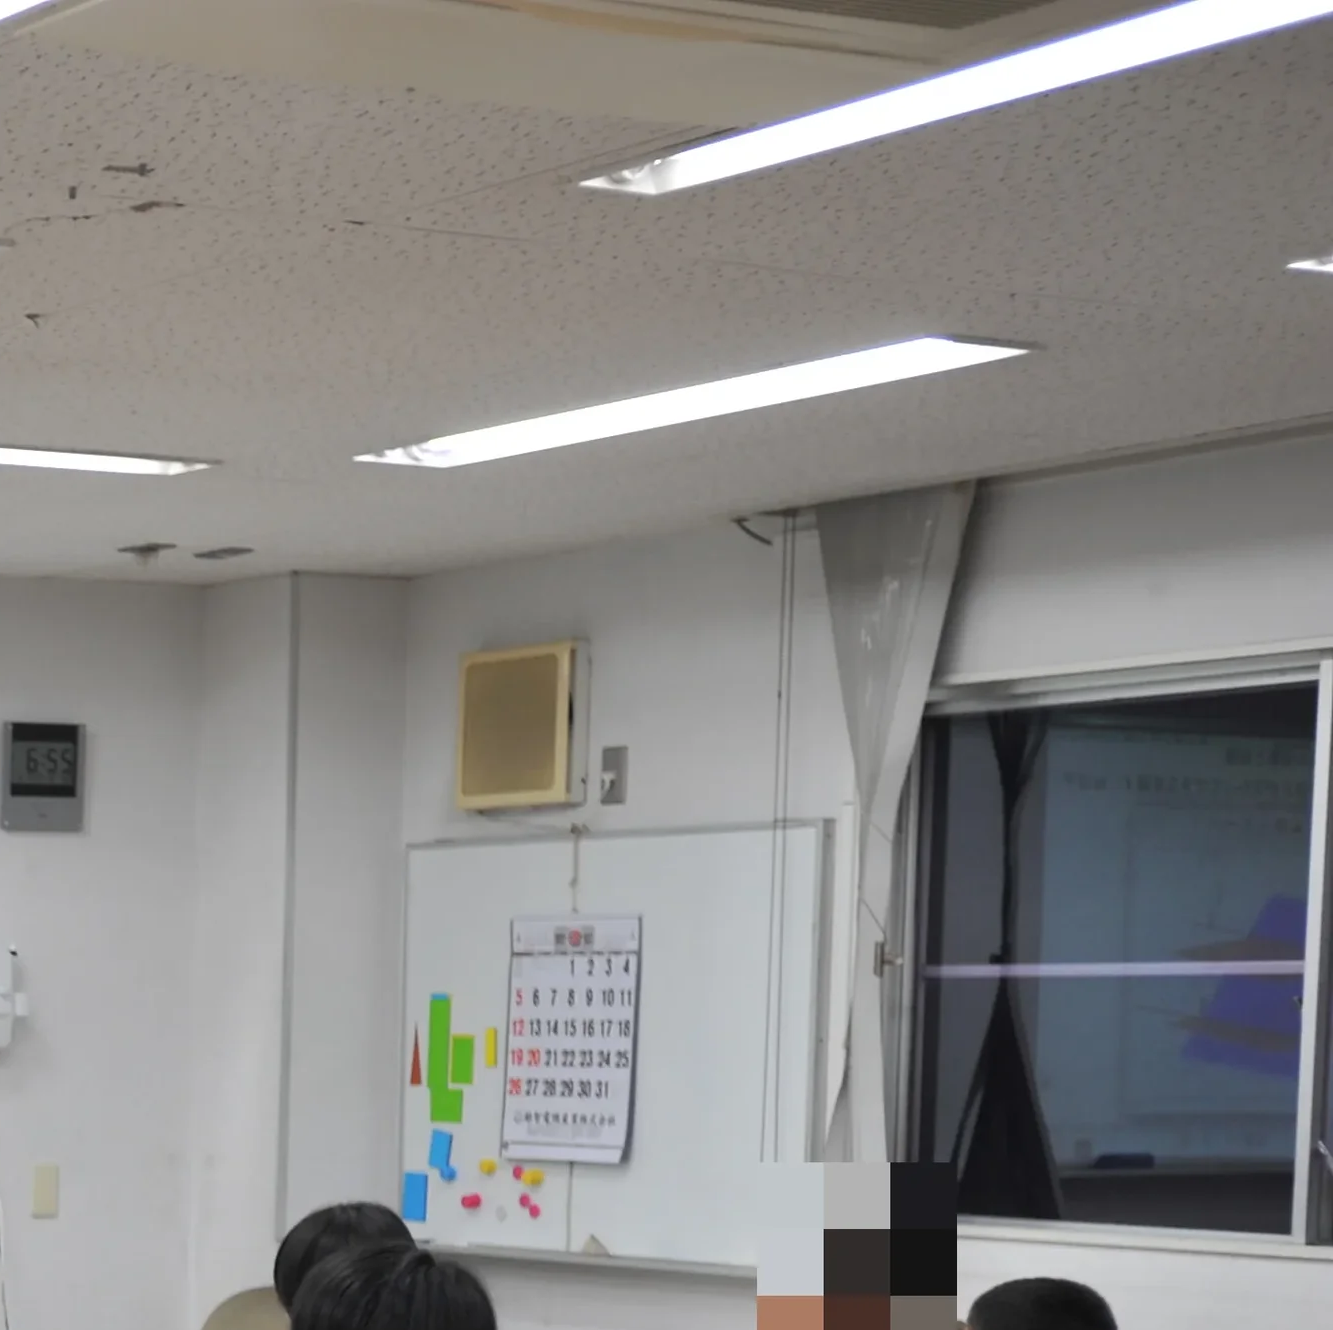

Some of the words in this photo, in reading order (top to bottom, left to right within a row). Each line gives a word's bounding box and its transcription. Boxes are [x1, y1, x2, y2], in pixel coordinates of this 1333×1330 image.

[569, 959, 575, 976] 1
[587, 958, 595, 976] 2
[605, 958, 612, 976] 3
[623, 958, 630, 975] 4
[515, 988, 523, 1006] 5
[532, 988, 540, 1006] 6
[550, 988, 558, 1006] 7
[567, 988, 575, 1006] 8
[585, 988, 593, 1006] 9
[602, 988, 615, 1006] 10
[620, 988, 632, 1006] 11
[512, 1019, 525, 1037] 12
[529, 1019, 541, 1037] 13
[547, 1019, 559, 1037] 14
[564, 1019, 577, 1037] 15
[582, 1019, 595, 1037] 16
[600, 1019, 613, 1037] 17
[618, 1019, 630, 1037] 18
[511, 1048, 523, 1066] 19
[544, 1049, 557, 1067] 21
[561, 1049, 575, 1067] 22
[597, 1049, 611, 1067] 24
[615, 1049, 629, 1068] 25
[525, 1078, 539, 1096] 27
[560, 1079, 574, 1097] 29
[577, 1080, 592, 1098] 30
[595, 1081, 609, 1099] 31
